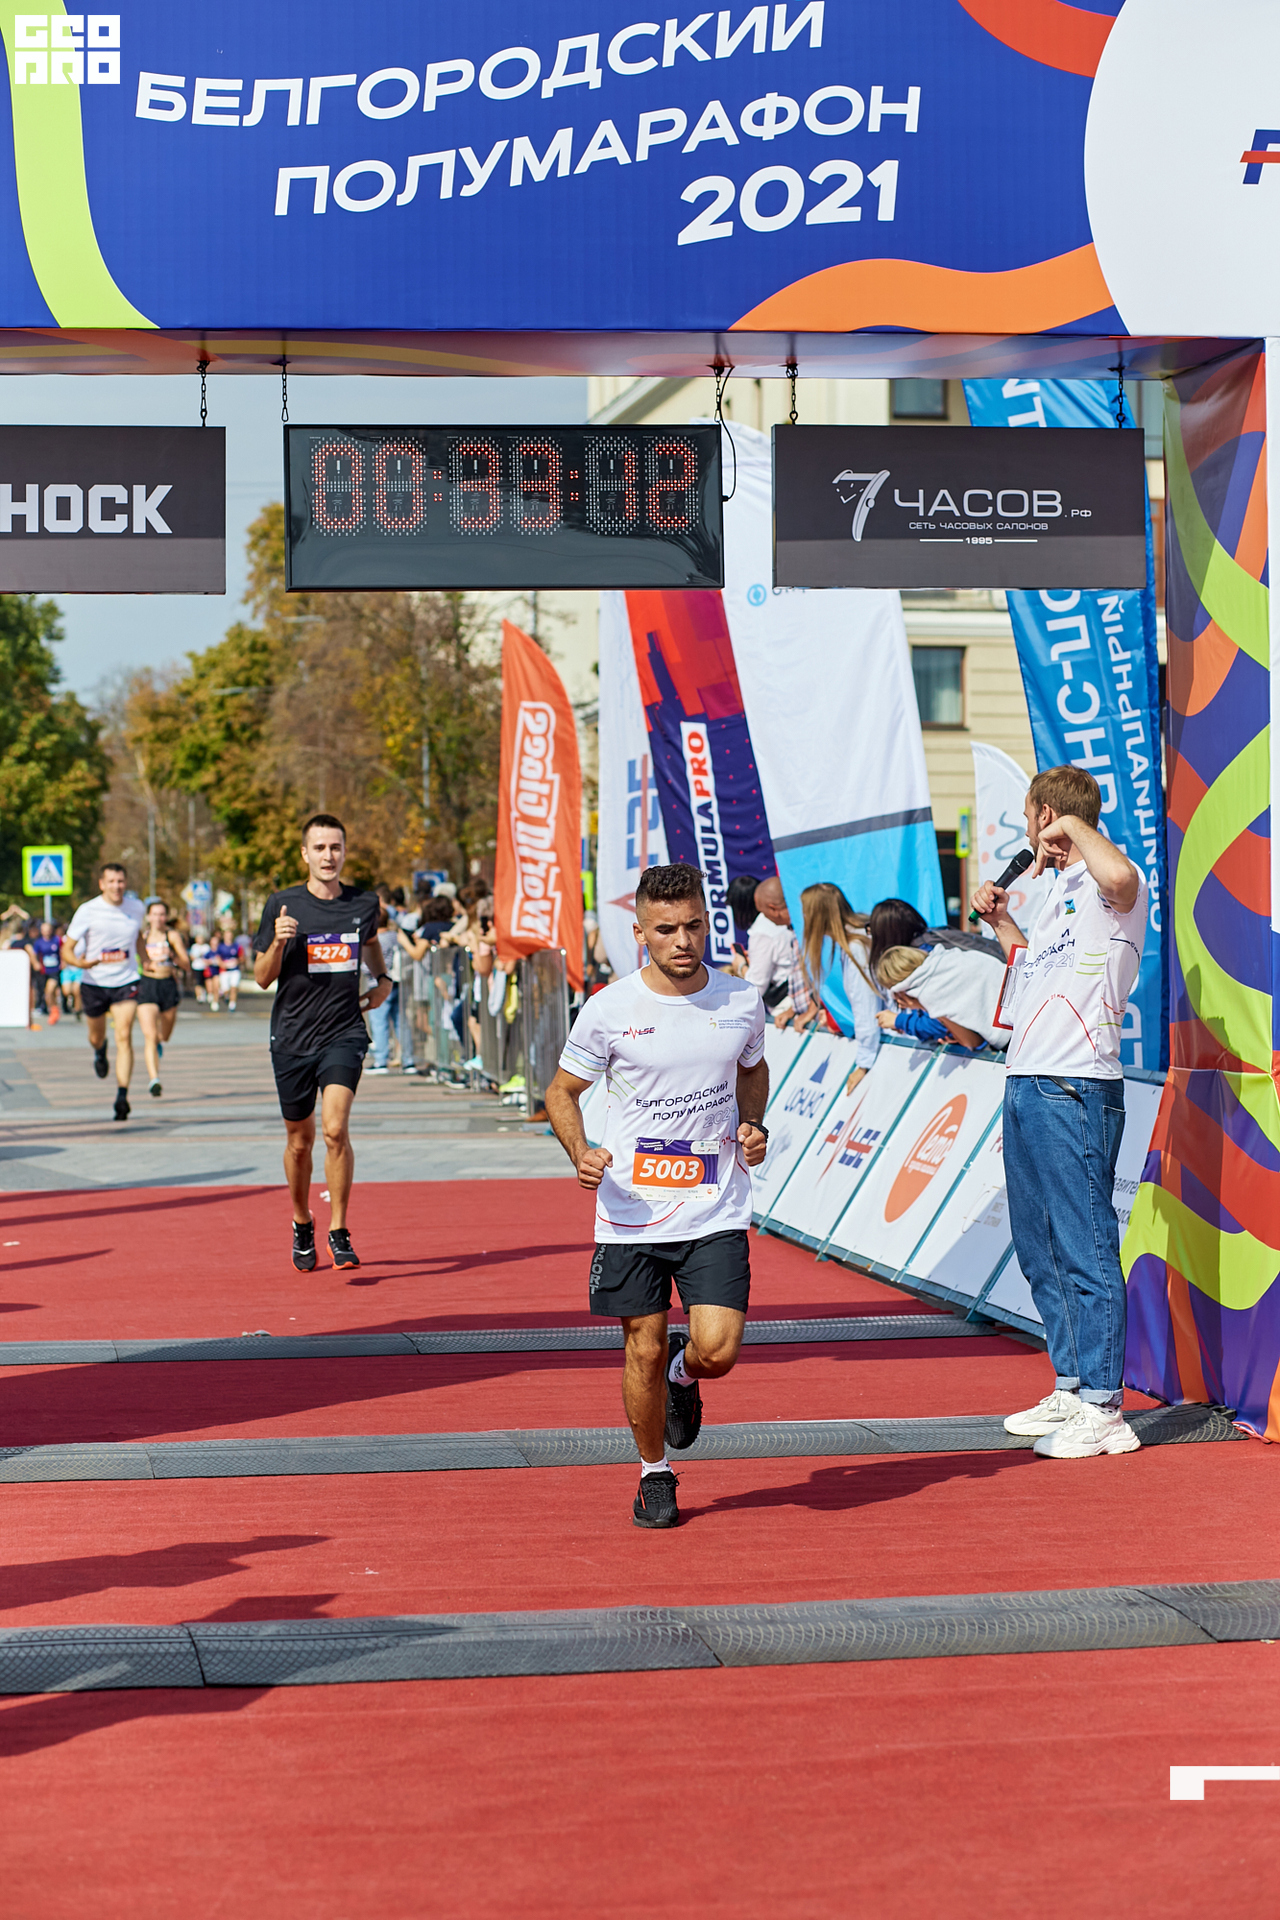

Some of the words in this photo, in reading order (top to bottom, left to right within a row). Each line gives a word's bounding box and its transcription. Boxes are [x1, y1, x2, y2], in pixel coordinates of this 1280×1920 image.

[274, 84, 921, 216] ПОЛУМАРАФОН
[677, 158, 899, 247] 2021
[908, 521, 936, 531] СЕТЬ
[939, 521, 993, 531] ЧАСОВЫХ
[996, 521, 1049, 531] САЛОНОВ
[965, 536, 993, 545] 1995
[312, 945, 349, 960] 5274
[635, 1080, 729, 1108] БЕЛГОРОДСКИЙ
[652, 1091, 734, 1121] ПОЛУМАРАФОН
[638, 1158, 700, 1180] 5003
[589, 1244, 607, 1295] SPORT
